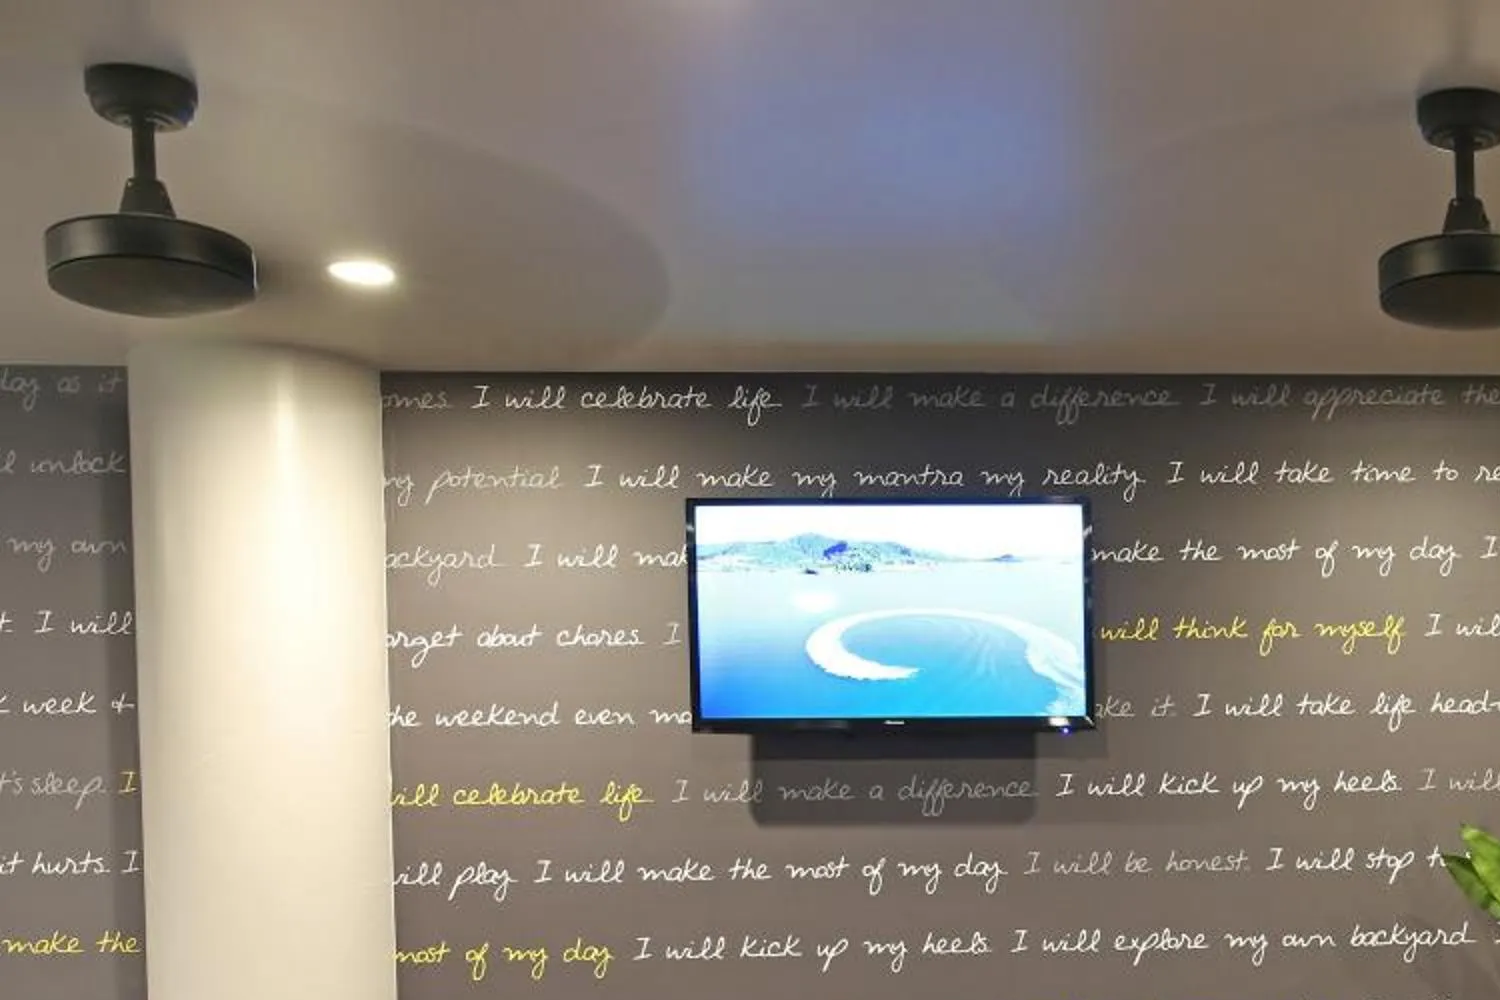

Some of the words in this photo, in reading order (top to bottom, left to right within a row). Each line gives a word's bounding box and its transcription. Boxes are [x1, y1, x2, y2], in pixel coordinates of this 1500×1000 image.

[469, 384, 492, 410] I
[504, 384, 567, 410] will
[579, 384, 714, 410] celebrate
[582, 462, 605, 489] I
[693, 462, 776, 490] make
[1198, 459, 1261, 486] will
[1272, 458, 1336, 485] take
[1349, 458, 1418, 484] time
[1431, 458, 1460, 482] to
[1177, 537, 1225, 562] the
[1235, 536, 1303, 562] most
[1313, 538, 1341, 580] of
[33, 608, 56, 635] I
[68, 610, 134, 636] will
[475, 622, 544, 650] about
[1170, 614, 1250, 641] think
[1258, 616, 1304, 658] for
[21, 689, 98, 717] week
[434, 699, 562, 729] weekend
[573, 707, 637, 727] even
[1294, 690, 1358, 718] take
[1368, 690, 1418, 734] life
[451, 780, 587, 808] celebrate
[1086, 770, 1148, 799] will
[1230, 773, 1266, 812] up
[1274, 776, 1322, 813] my
[563, 857, 626, 885] will
[726, 856, 774, 882] the
[783, 854, 852, 881] most
[860, 855, 888, 898] of
[895, 860, 944, 897] my
[1123, 849, 1154, 874] be
[1363, 845, 1416, 886] stop
[0, 928, 86, 956] make
[94, 928, 141, 954] the
[463, 940, 491, 983] of
[500, 945, 551, 982] my
[815, 936, 850, 974] up
[860, 938, 910, 975] my
[1112, 926, 1211, 968] explore
[1280, 932, 1338, 950] own
